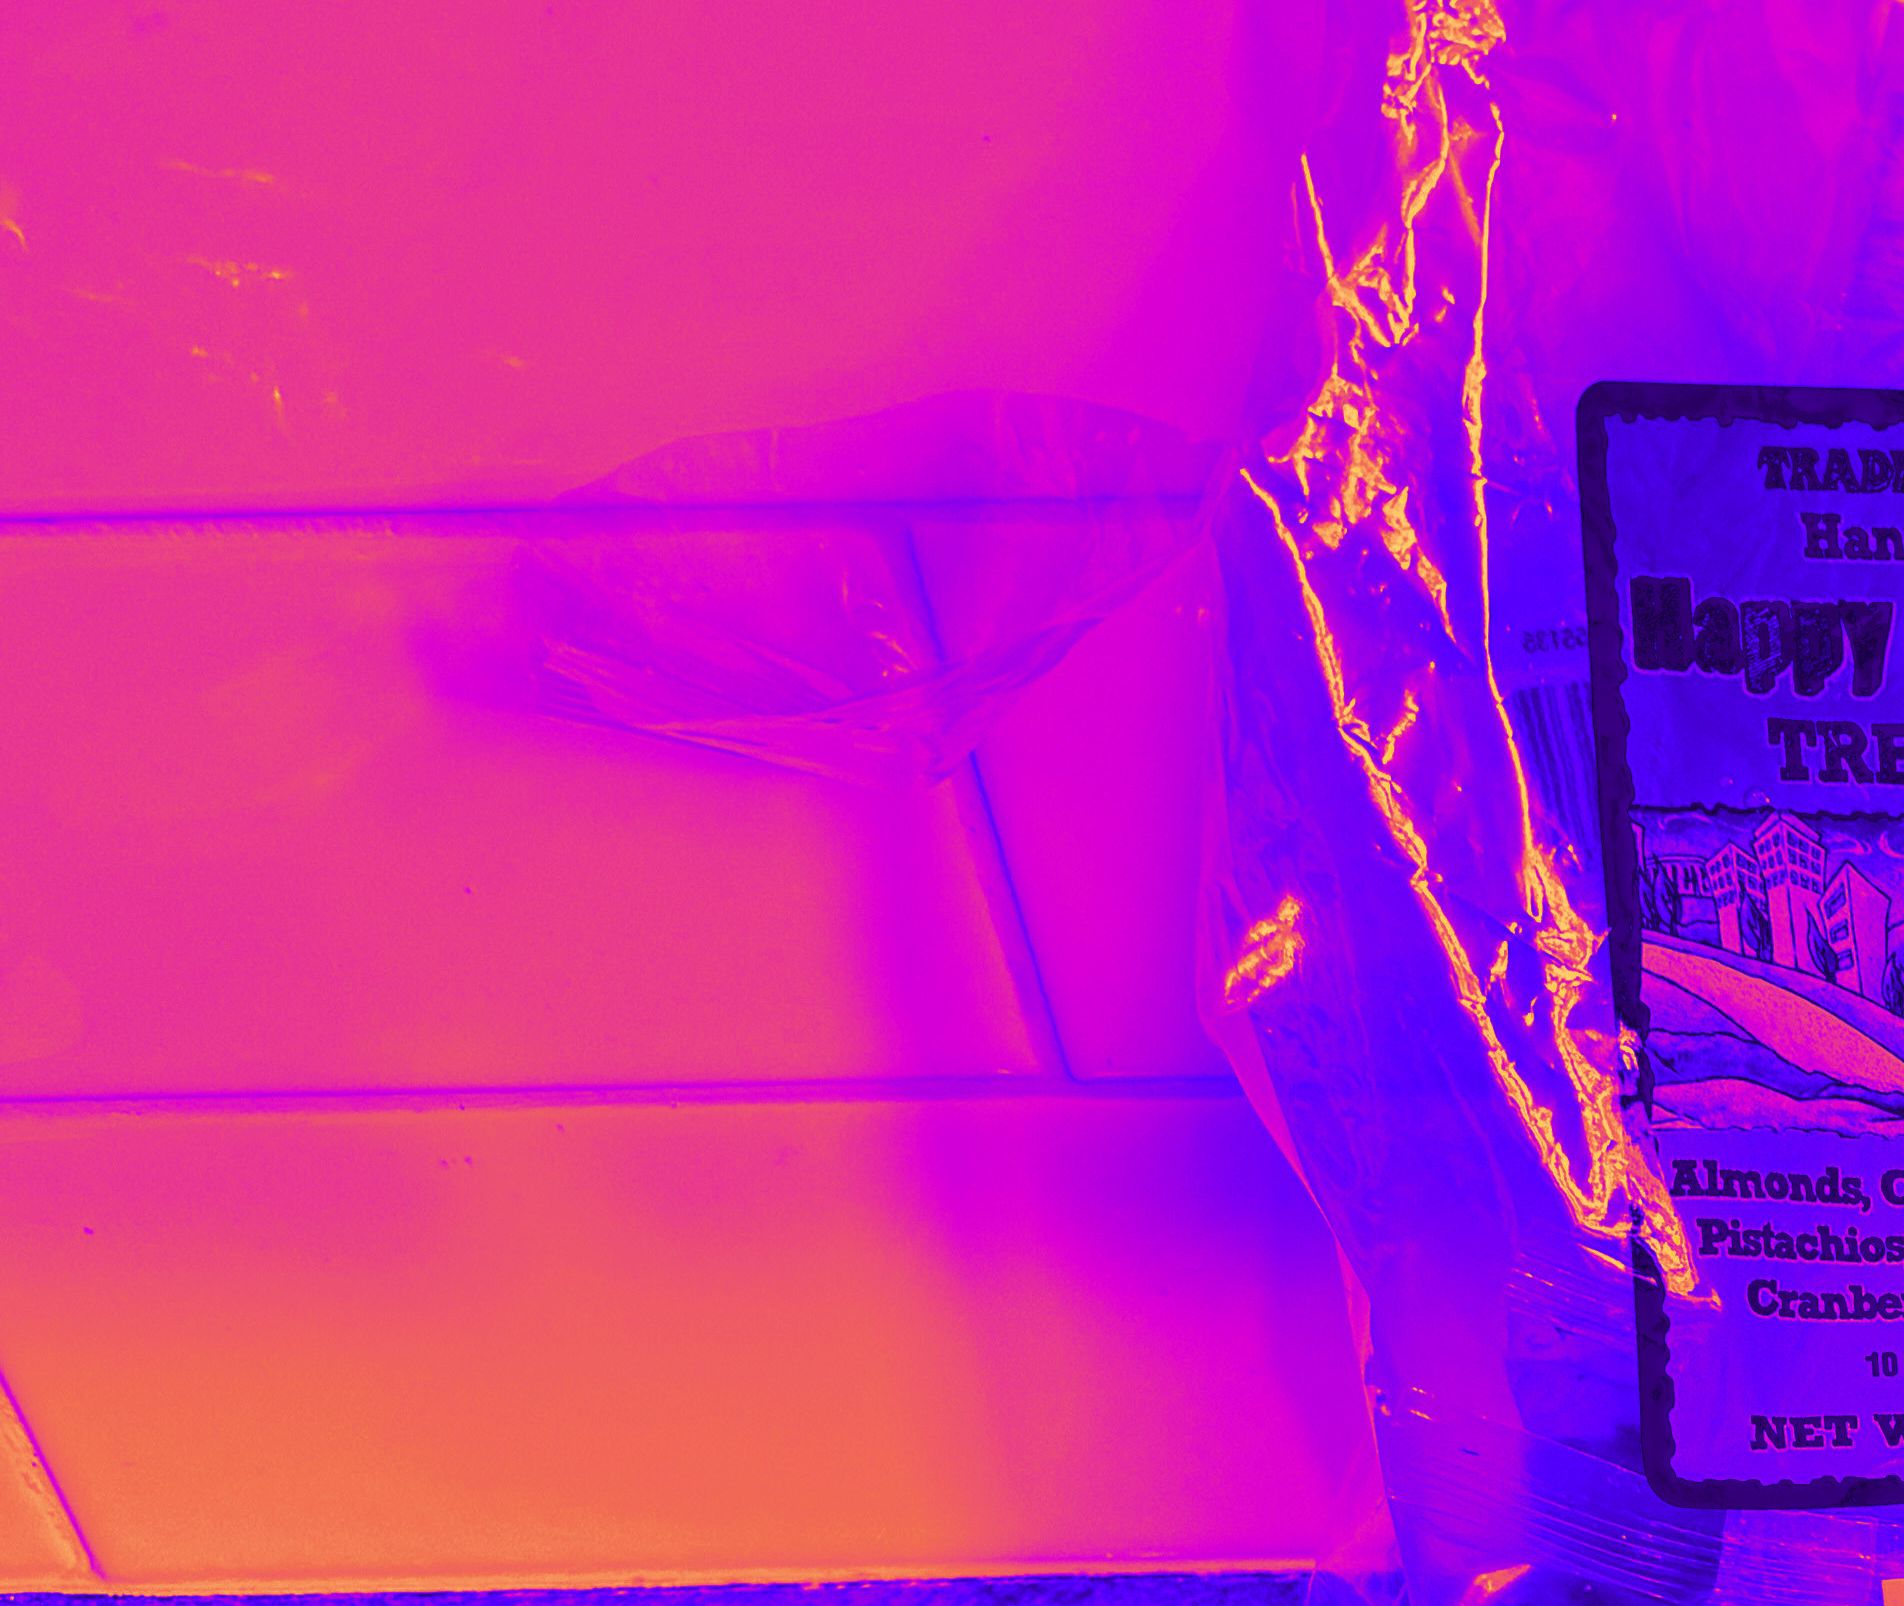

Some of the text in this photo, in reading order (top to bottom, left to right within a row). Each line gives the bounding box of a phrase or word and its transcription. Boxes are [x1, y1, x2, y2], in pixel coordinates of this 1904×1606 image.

[1628, 575, 1896, 699] Happy
[1670, 1158, 1874, 1213] Almonds,
[1866, 1349, 1898, 1379] 10
[1749, 1415, 1859, 1453] NET
